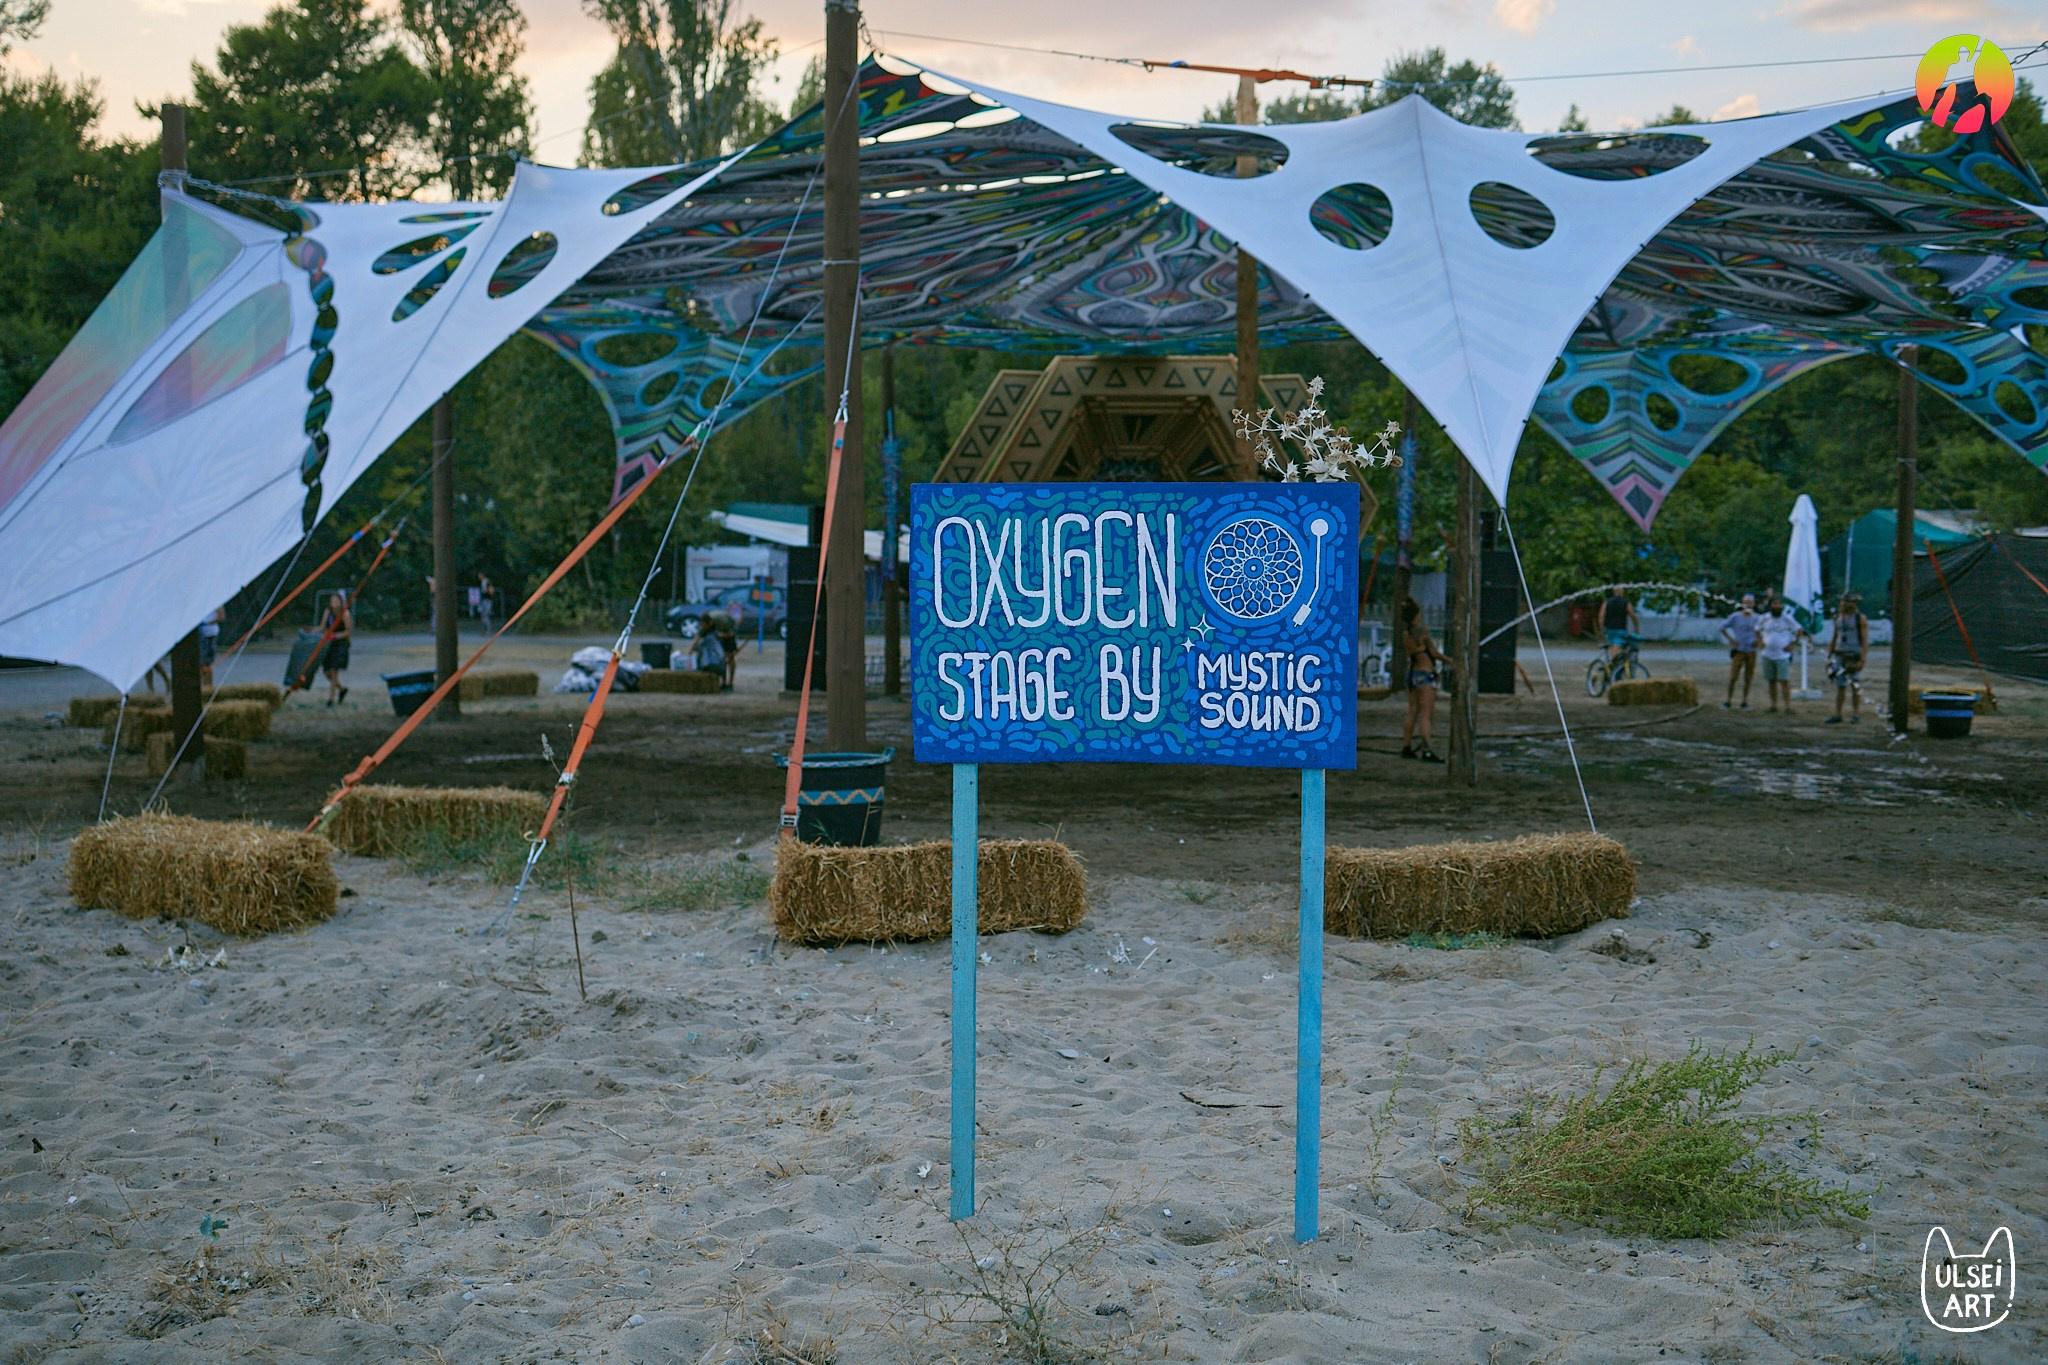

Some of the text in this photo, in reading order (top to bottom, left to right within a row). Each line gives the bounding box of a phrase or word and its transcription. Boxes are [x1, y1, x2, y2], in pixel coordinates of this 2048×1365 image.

[934, 511, 1176, 628] OXYGEN
[938, 644, 1161, 722] STAGE BY
[1200, 692, 1320, 731] SOUND
